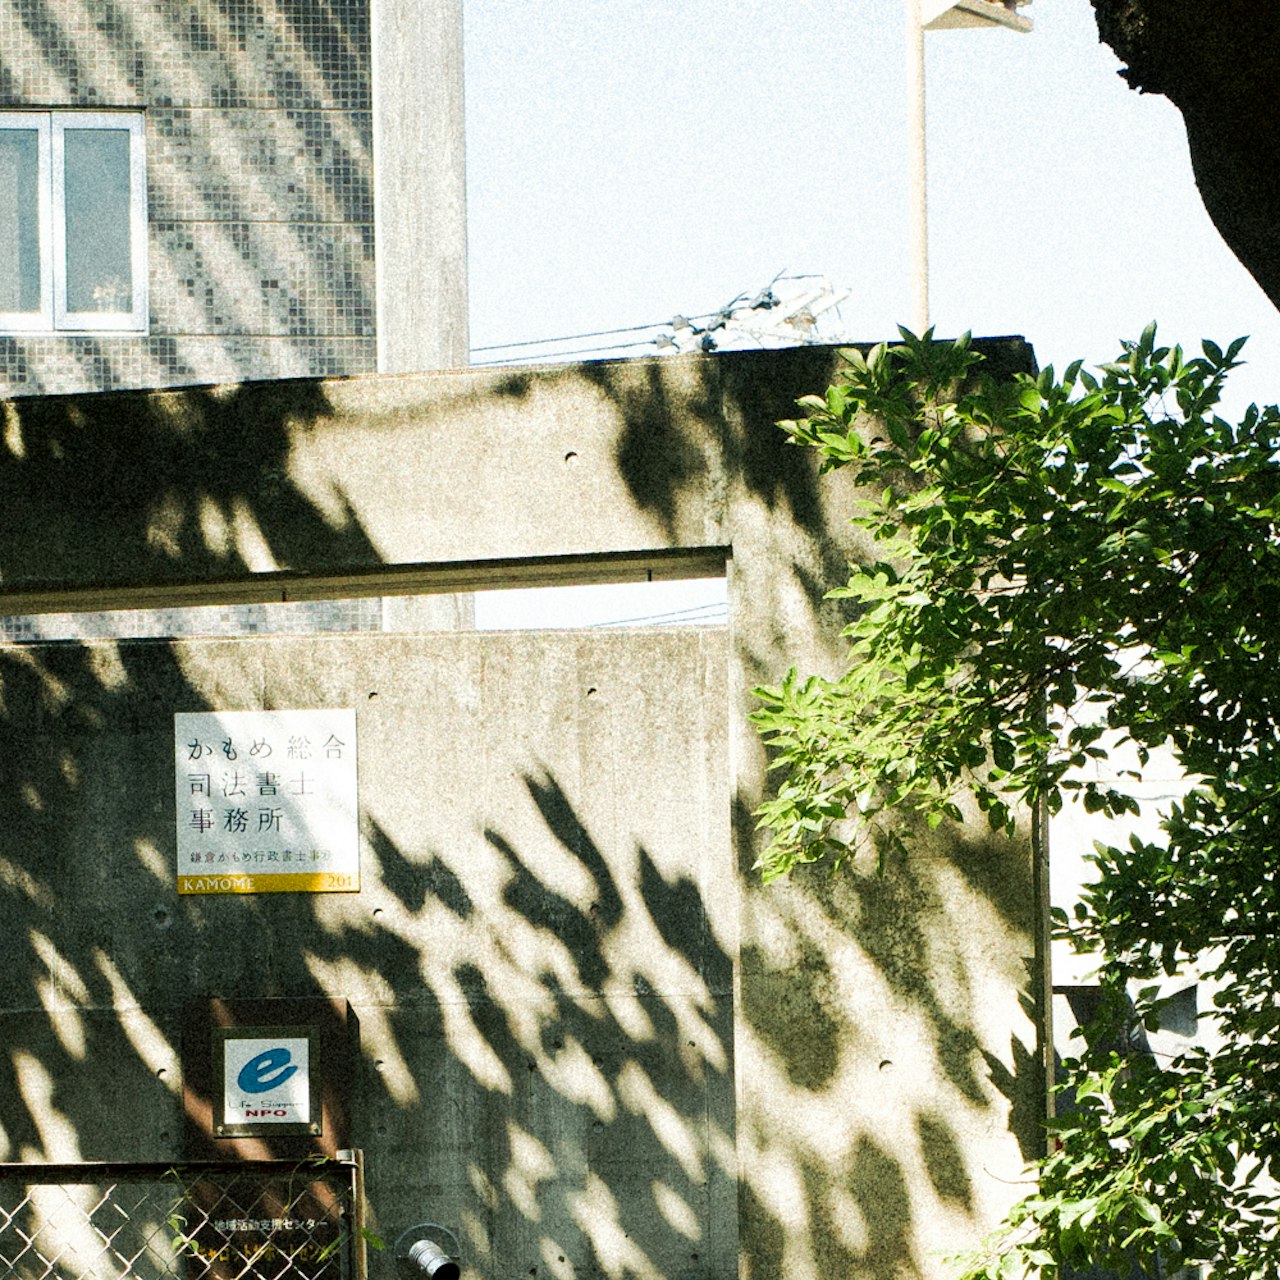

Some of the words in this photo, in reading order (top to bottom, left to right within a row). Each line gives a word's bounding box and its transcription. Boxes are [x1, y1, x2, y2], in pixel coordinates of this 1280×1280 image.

[188, 734, 345, 760] かもめ総合
[188, 771, 315, 798] 司法書士
[189, 807, 283, 834] 事務所
[190, 850, 334, 863] 鎌倉かもめ行政書士事
[184, 877, 255, 891] KAMOME
[328, 875, 352, 888] 201
[245, 1109, 287, 1117] NPO
